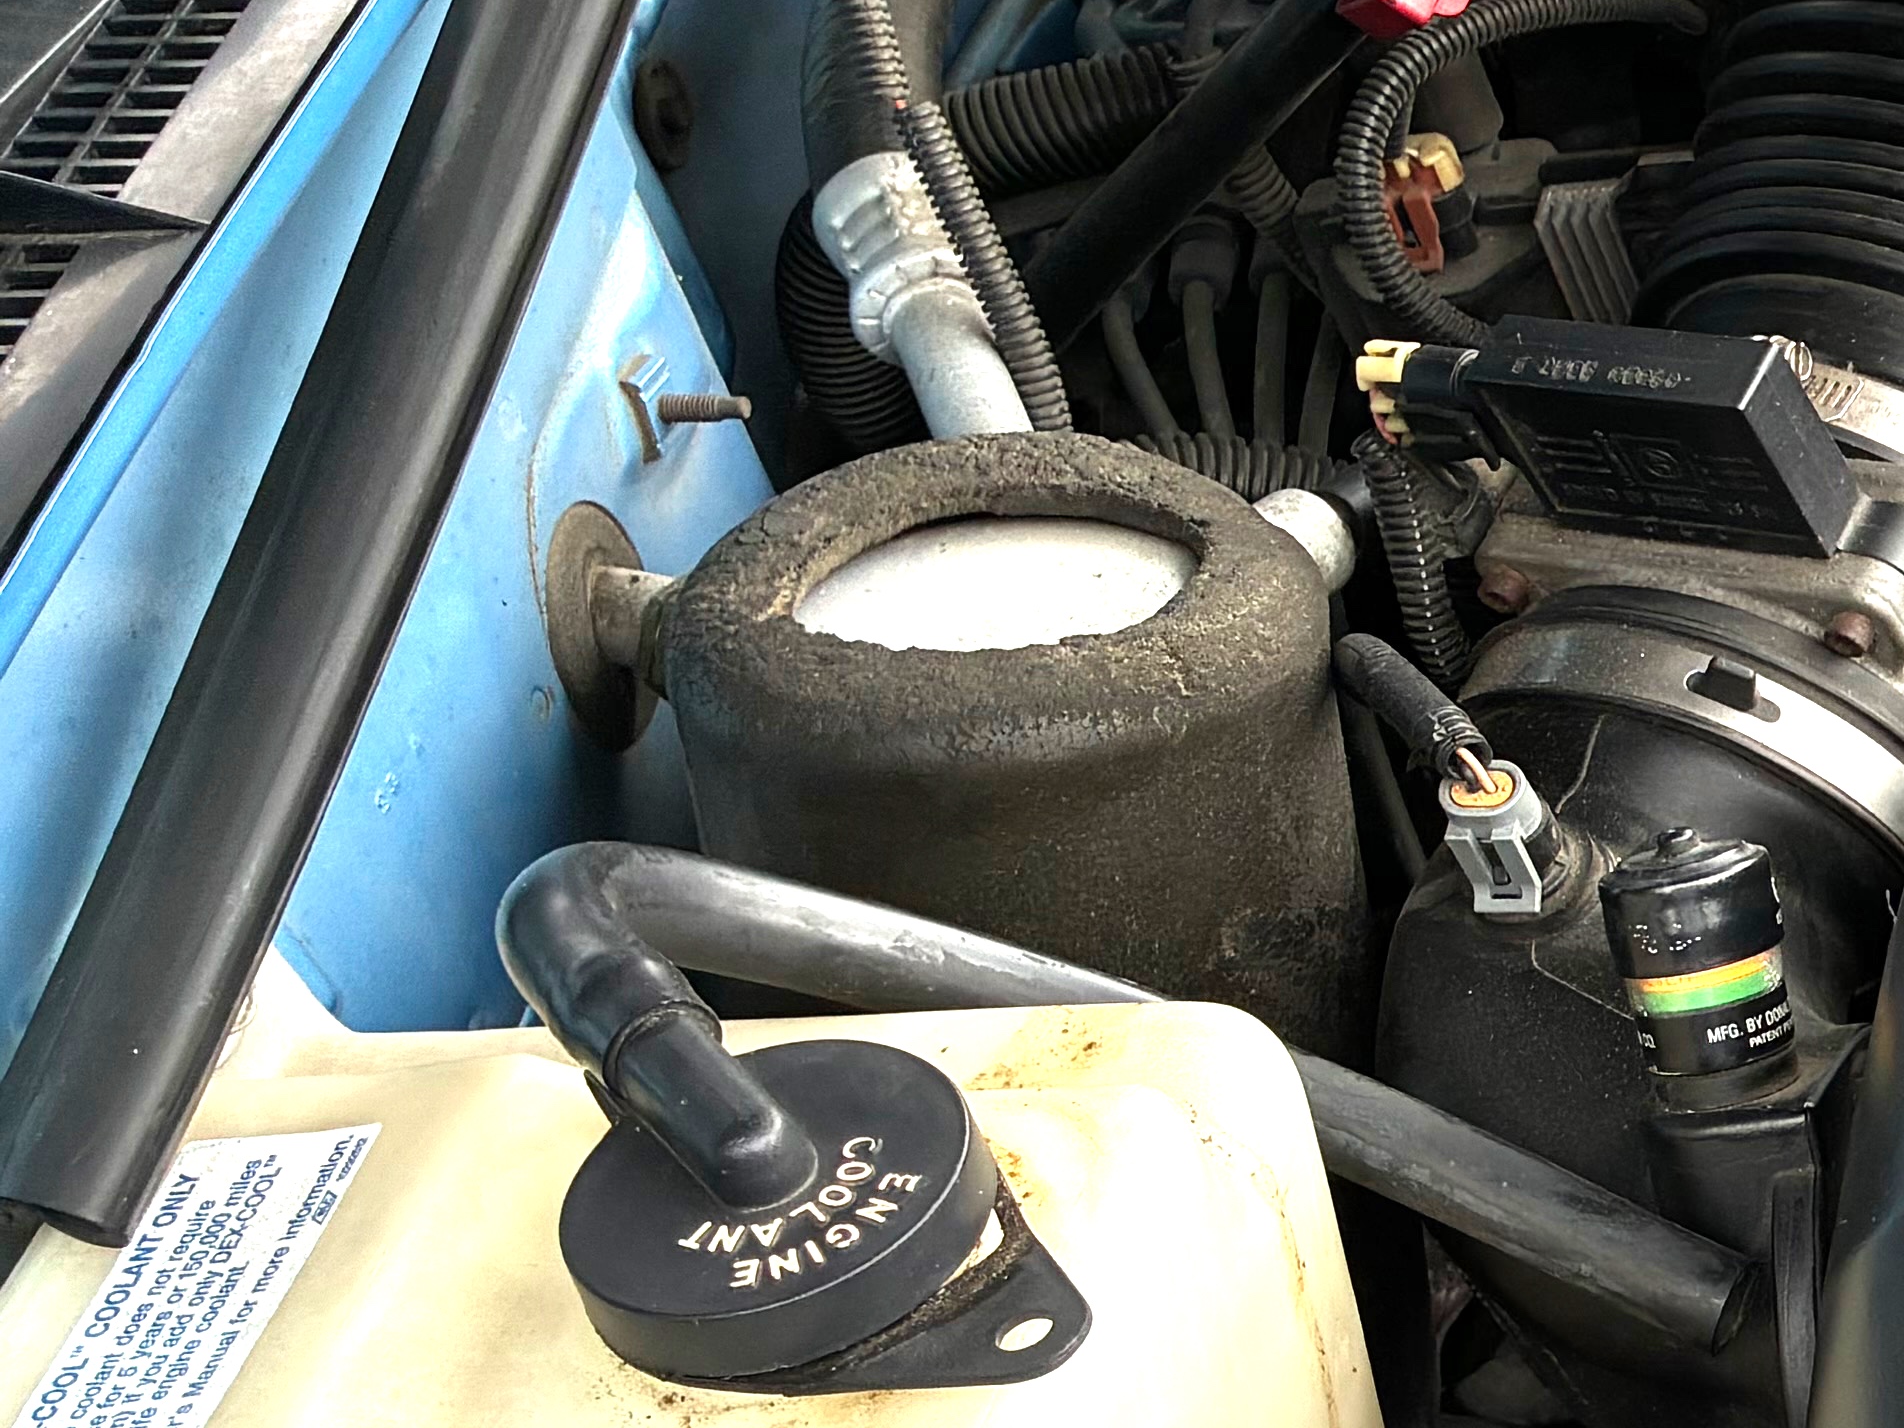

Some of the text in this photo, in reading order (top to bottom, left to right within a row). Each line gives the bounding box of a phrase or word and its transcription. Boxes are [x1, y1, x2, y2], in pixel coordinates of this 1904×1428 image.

[1706, 1022, 1743, 1043] MFG.
[1745, 1014, 1762, 1033] BY
[1748, 1026, 1783, 1048] PATENT
[677, 1135, 882, 1253] COOLANT
[729, 1171, 922, 1289] ENGINE
[69, 1351, 124, 1420] coolant
[114, 1301, 155, 1346] does
[146, 1266, 177, 1296] not
[167, 1199, 216, 1262] require
[84, 1233, 163, 1338] COOLANT
[151, 1172, 200, 1228] ONLY
[95, 1383, 126, 1409] for
[129, 1309, 173, 1360] years
[165, 1284, 188, 1305] or
[177, 1211, 232, 1280] 150,000
[223, 1158, 262, 1207] miles
[135, 1353, 170, 1387] you
[162, 1312, 195, 1348] add
[187, 1269, 224, 1307] only
[150, 1338, 202, 1401] engine
[181, 1329, 240, 1398] Manual
[227, 1298, 258, 1325] for
[250, 1245, 290, 1294] more
